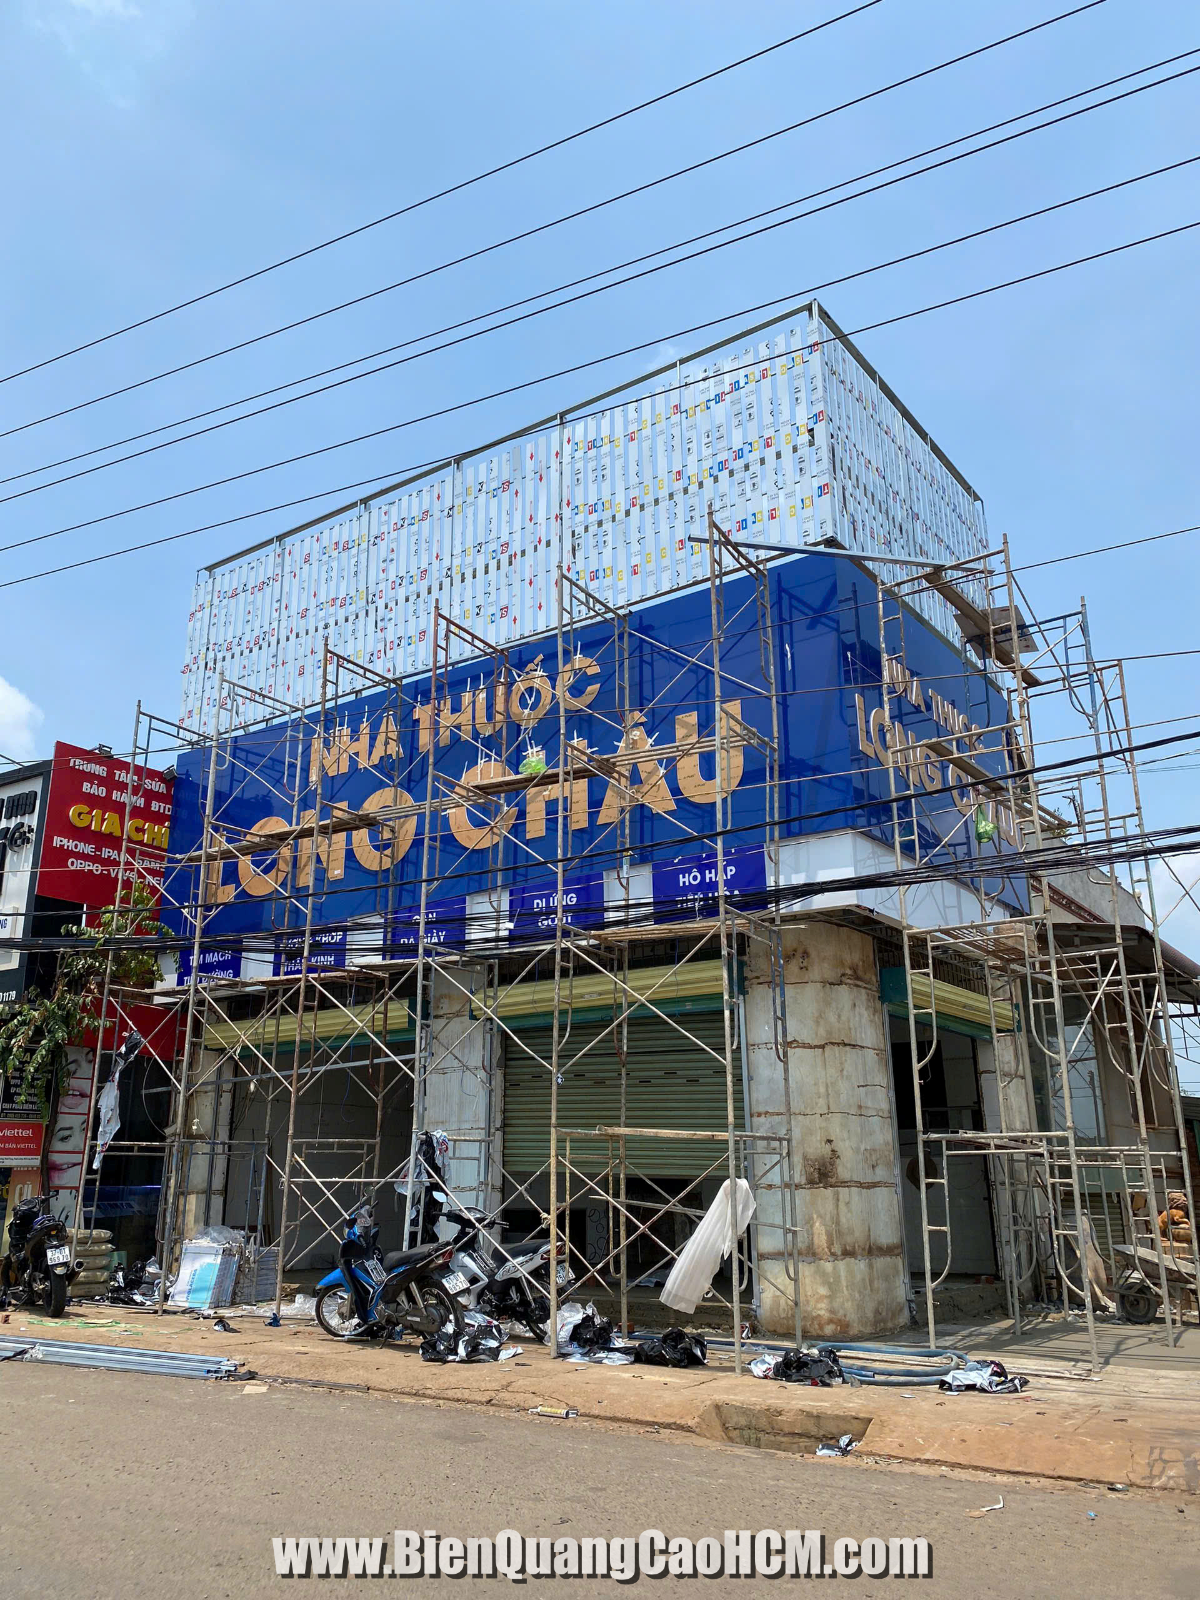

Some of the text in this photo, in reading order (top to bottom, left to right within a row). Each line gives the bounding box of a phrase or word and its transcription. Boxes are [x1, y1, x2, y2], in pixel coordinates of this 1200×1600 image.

[69, 757, 107, 777] TRUNG
[82, 780, 106, 798] BẢO
[69, 804, 170, 849] GIA CHÍ
[67, 857, 102, 875] OPPO
[679, 867, 701, 887] HÔ
